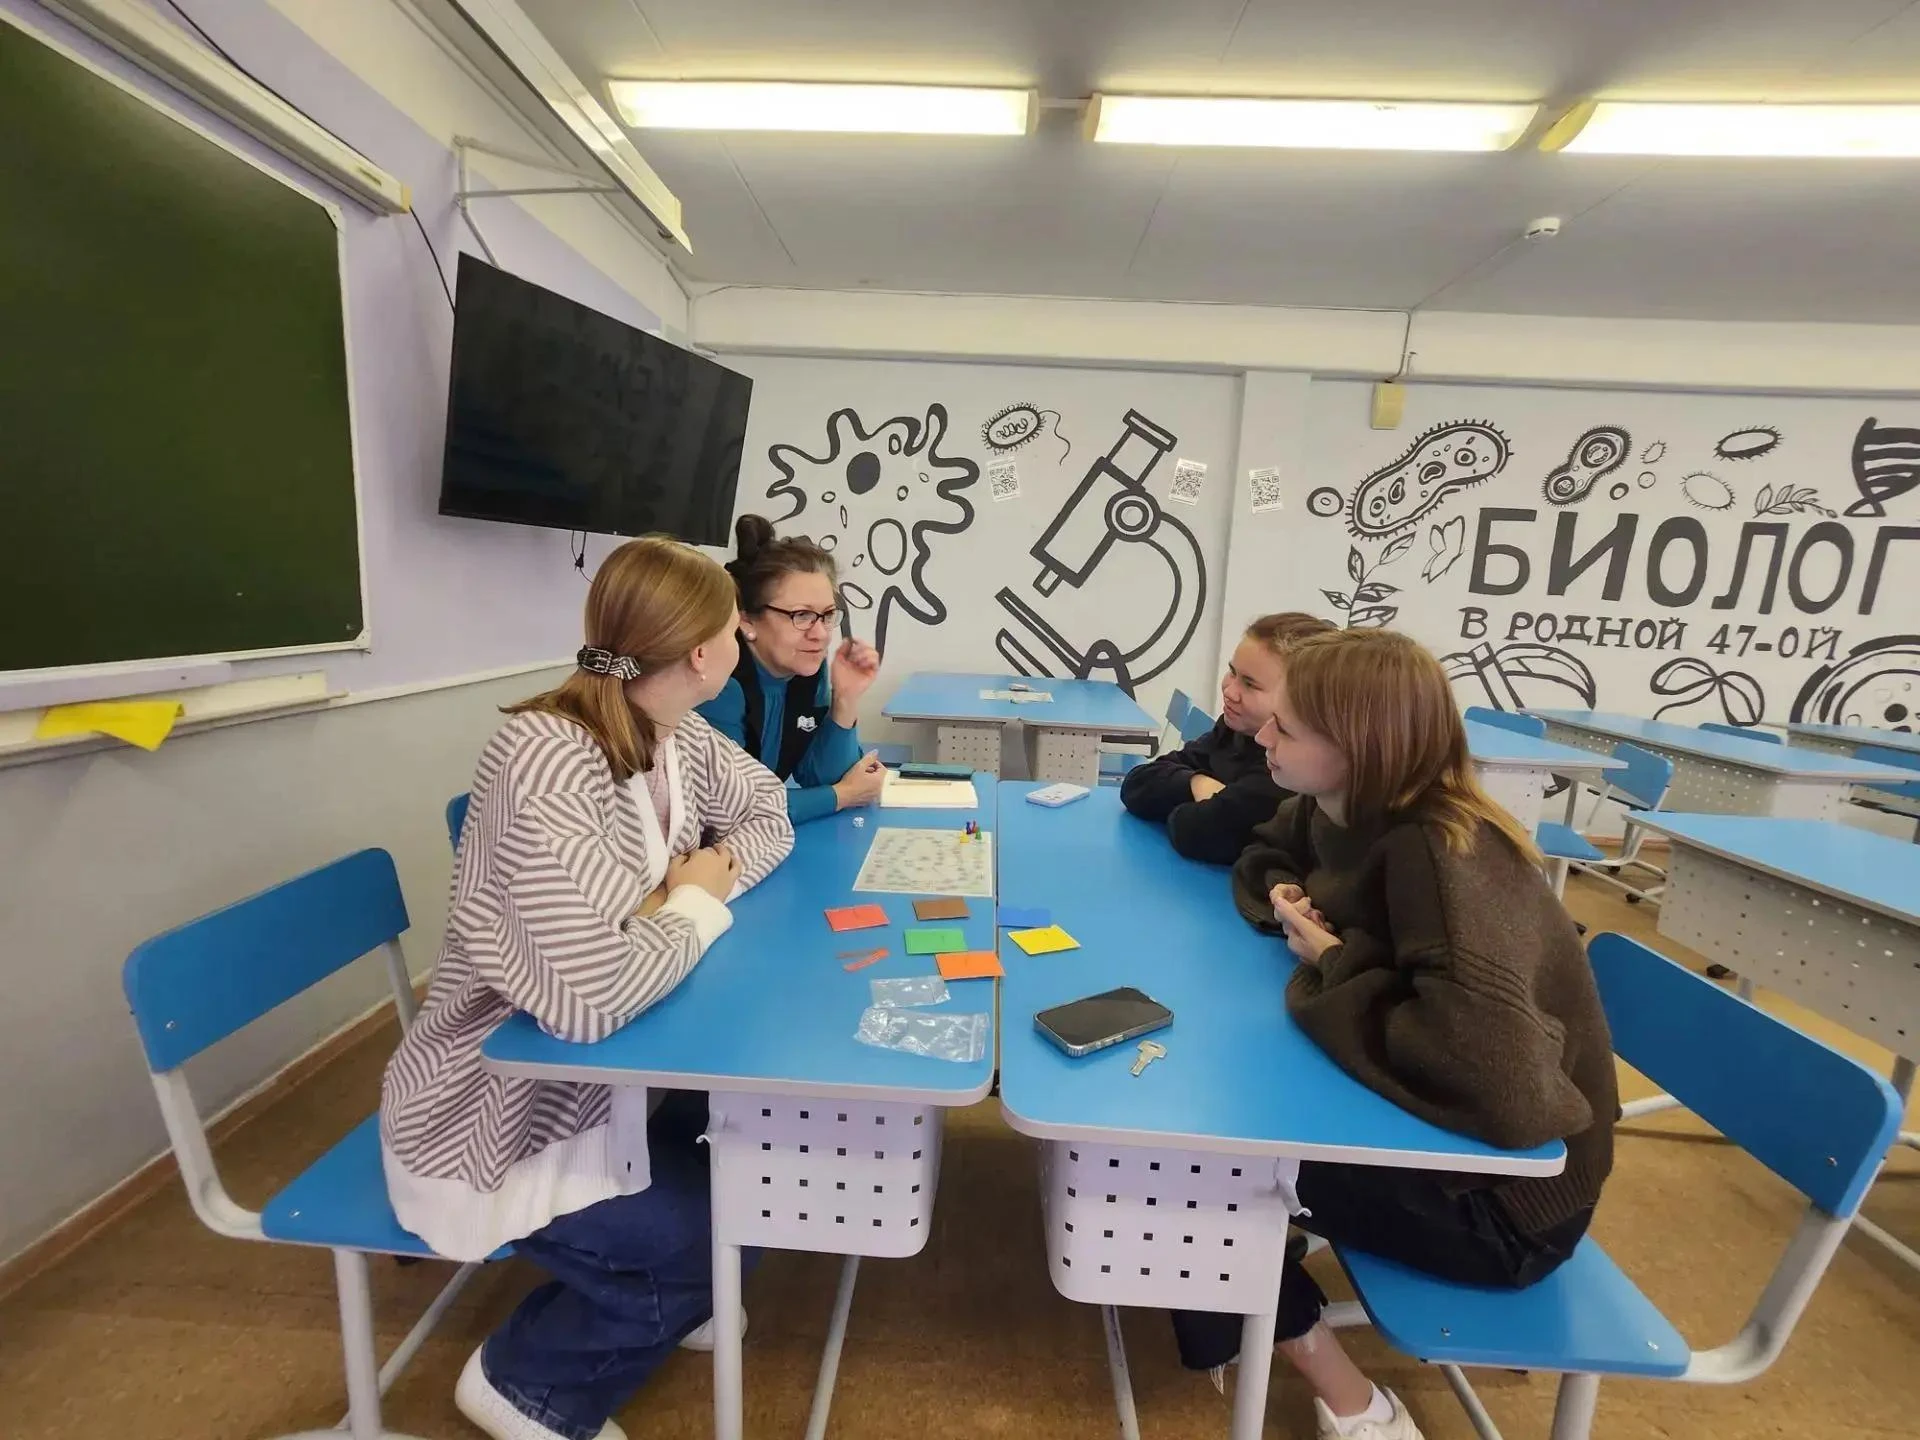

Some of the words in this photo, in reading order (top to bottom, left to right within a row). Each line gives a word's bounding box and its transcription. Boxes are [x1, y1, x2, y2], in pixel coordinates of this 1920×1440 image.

[1459, 607, 1488, 639] В
[1504, 611, 1688, 651] РОДНОЙ
[1706, 623, 1843, 660] 47-ОЙ
